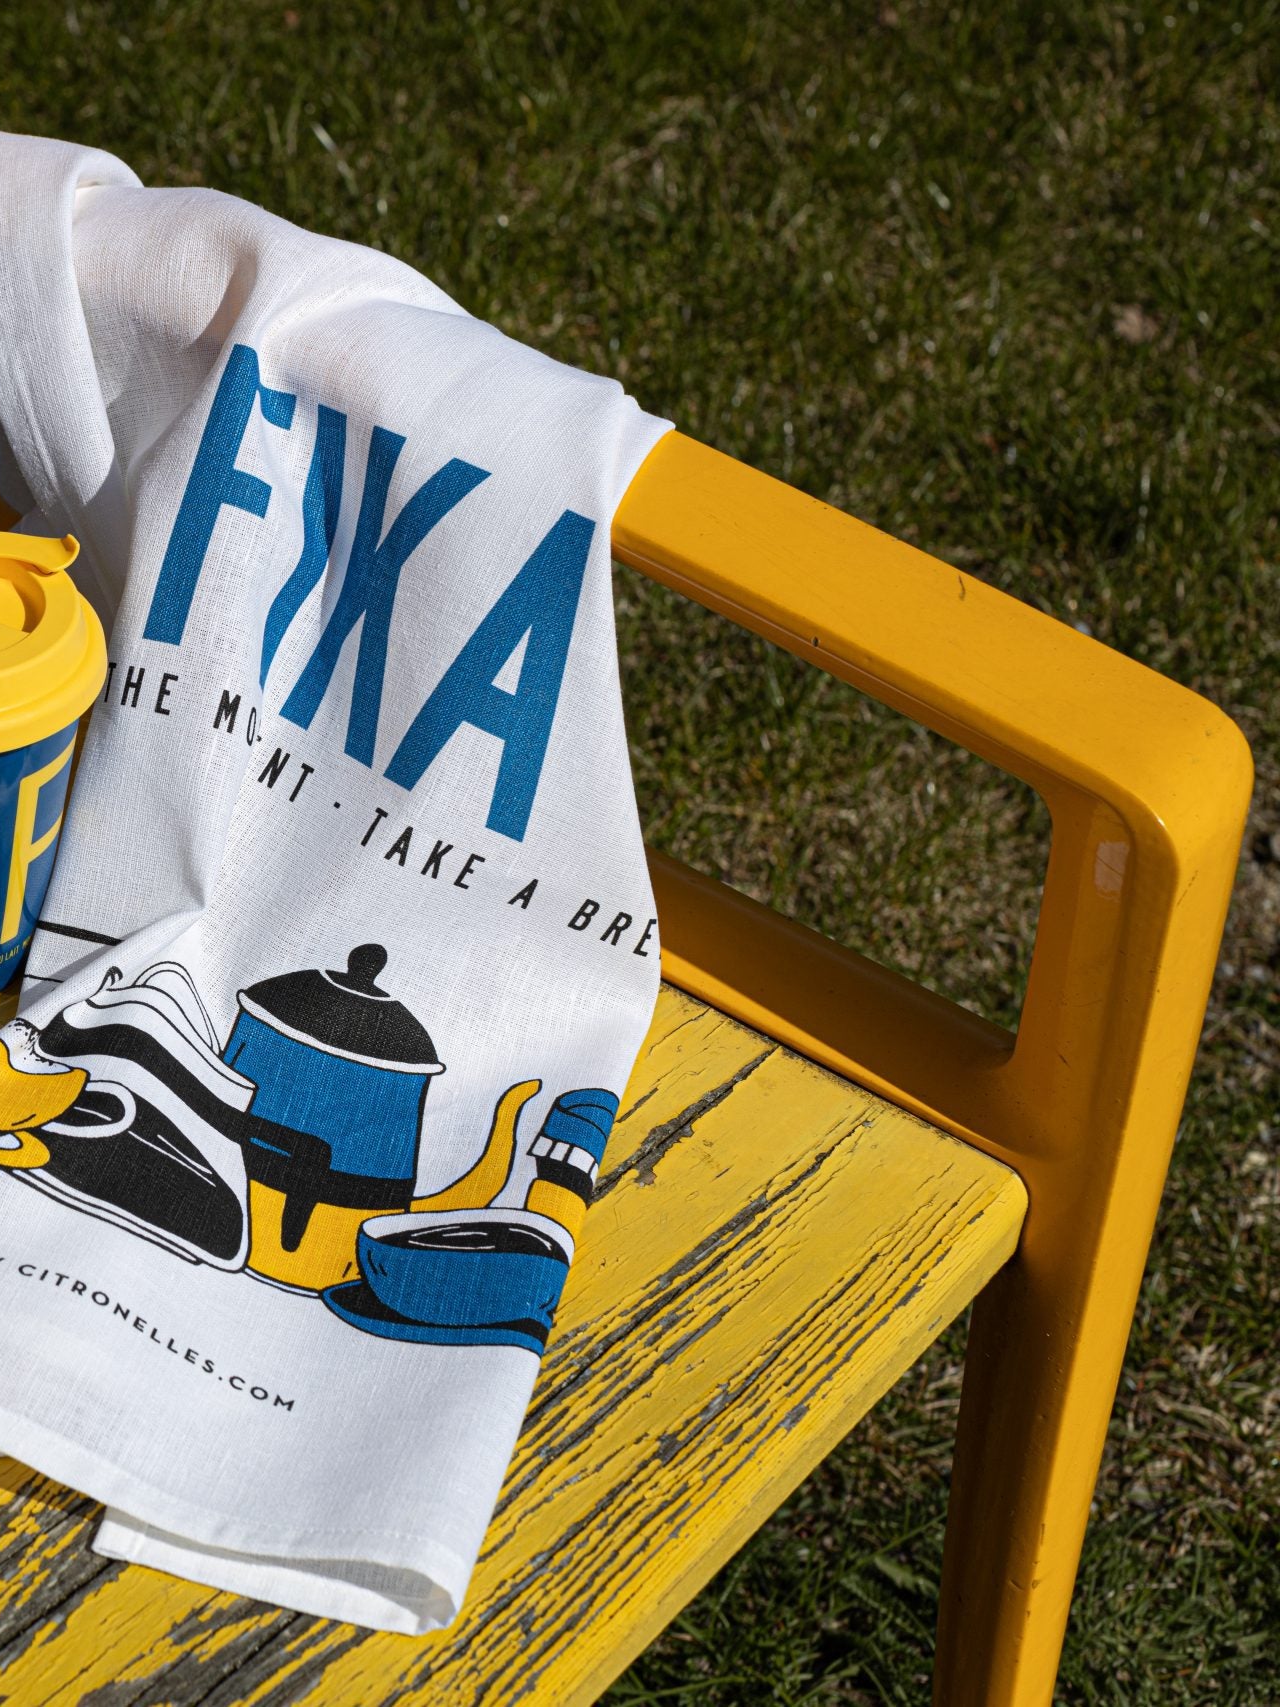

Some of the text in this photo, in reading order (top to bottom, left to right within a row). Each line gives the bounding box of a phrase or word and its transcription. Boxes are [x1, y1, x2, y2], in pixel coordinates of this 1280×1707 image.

[142, 344, 597, 844] FIKA
[104, 662, 659, 959] THE MONT TAKE A BRE
[18, 1263, 297, 1413] CITRONELLES.COM
